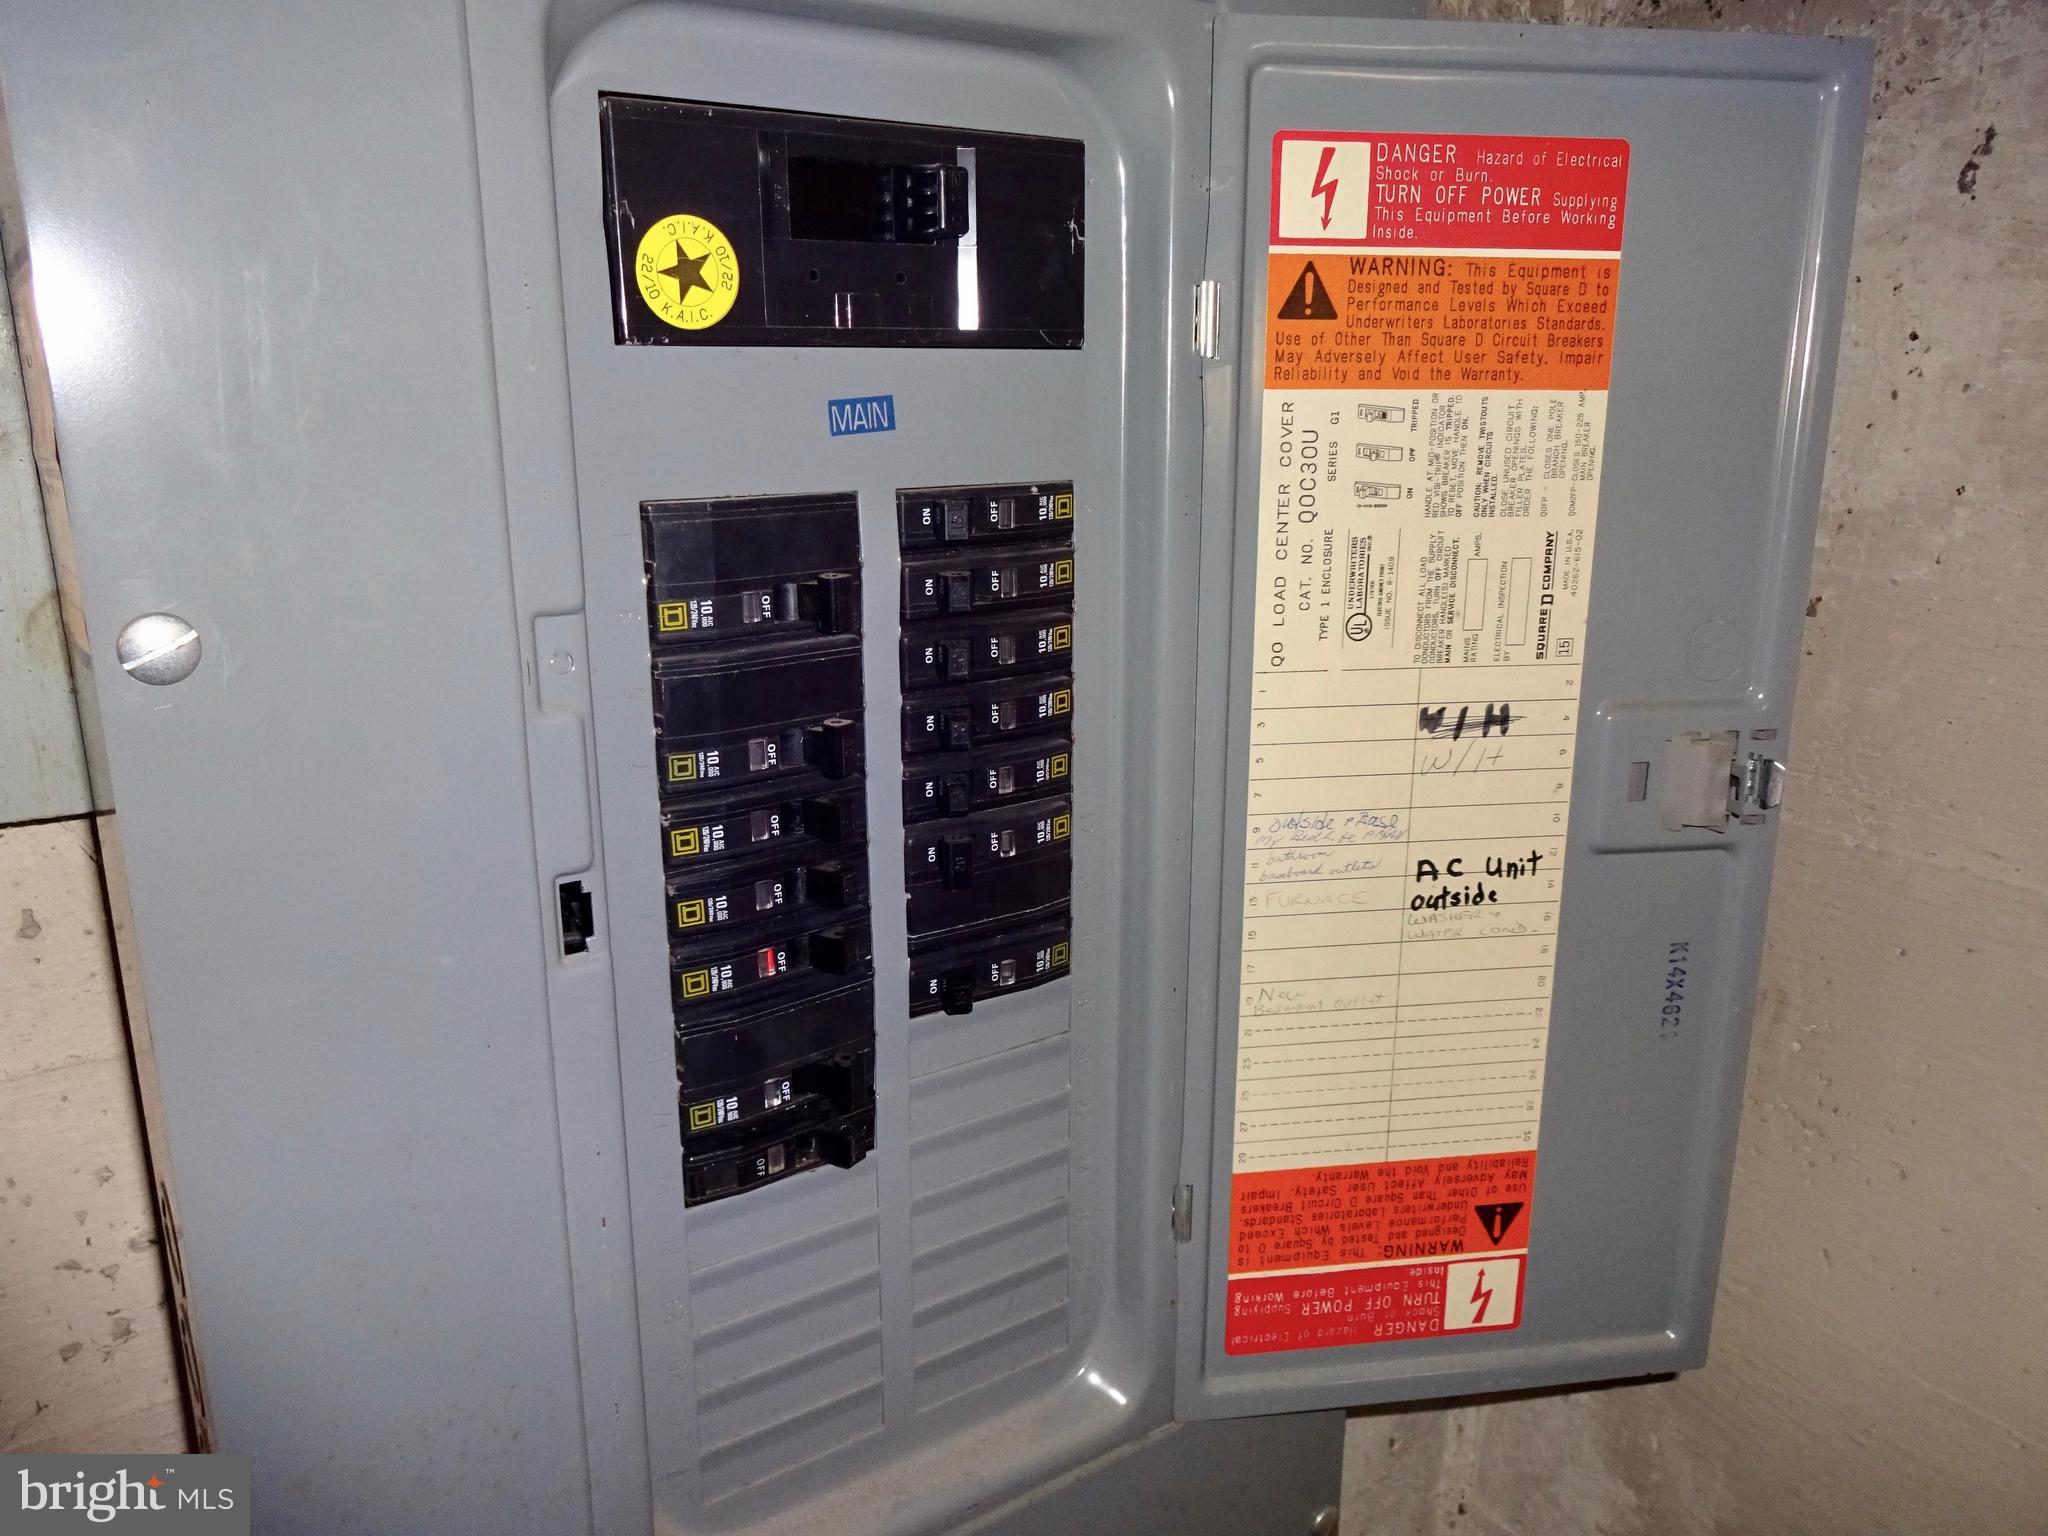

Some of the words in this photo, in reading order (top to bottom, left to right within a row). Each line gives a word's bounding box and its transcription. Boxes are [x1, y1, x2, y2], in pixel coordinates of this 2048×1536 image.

[1376, 143, 1457, 163] DANGER
[1477, 152, 1523, 165] Hazard
[1533, 152, 1546, 166] of
[1556, 152, 1622, 168] Electrical
[1376, 166, 1418, 181] Shock
[1430, 169, 1444, 181] or
[1456, 169, 1493, 182] Burn.
[1376, 184, 1421, 203] TURN
[1436, 186, 1466, 204] OFF
[1482, 187, 1540, 206] POWER
[1553, 193, 1617, 211] Supplying
[1375, 207, 1403, 221] This
[1415, 208, 1491, 225] Equipment
[1502, 210, 1550, 224] Before
[1561, 211, 1616, 229] Working
[1372, 225, 1418, 239] Inside.
[1350, 257, 1452, 277] WARNING:
[1466, 263, 1495, 277] This
[1508, 264, 1586, 282] Equipment
[1598, 266, 1610, 279] is
[1348, 280, 1408, 297] Designed
[1418, 281, 1440, 295] and
[1451, 281, 1494, 295] Tested
[1503, 281, 1516, 298] by
[1527, 282, 1570, 298] Square
[1579, 283, 1587, 296] D
[1597, 284, 1608, 296] to
[1347, 298, 1438, 313] Performance
[1450, 299, 1495, 313] Levels
[1507, 299, 1546, 313] Which
[1557, 300, 1606, 314] Exceed
[1346, 315, 1433, 330] Underwriters
[1444, 316, 1527, 331] Laboratories
[1537, 317, 1605, 332] Standards.
[1276, 331, 1301, 345] Use
[1312, 331, 1324, 346] of
[1335, 332, 1372, 346] Other
[1382, 332, 1411, 346] Than
[1421, 333, 1465, 349] Square
[1475, 333, 1483, 346] D
[1493, 334, 1537, 347] Circuit
[1547, 335, 1603, 348] Breakers
[1275, 350, 1302, 366] May
[1316, 350, 1386, 366] Adversely
[1397, 351, 1444, 364] Affect
[1454, 351, 1487, 364] User
[1497, 352, 1548, 368] Safety.
[1560, 352, 1603, 368] Impair
[1274, 367, 1348, 383] Reliability
[1359, 367, 1380, 381] and
[1393, 367, 1419, 381] Void
[1430, 368, 1450, 381] the
[1461, 368, 1524, 384] Warranty.
[831, 402, 889, 433] MAIN
[1330, 411, 1339, 425] G1
[1411, 399, 1419, 432] TRIPPED
[1479, 397, 1488, 438] TWISTOUTS
[1279, 402, 1294, 467] COVER
[1484, 432, 1493, 467] CIRCUITS
[1328, 441, 1338, 482] SERIES
[1476, 446, 1484, 475] REMOVE
[1482, 472, 1490, 493] WHEN
[1407, 488, 1413, 499] ON
[1473, 482, 1482, 517] CAUTION:
[1489, 474, 1498, 517] INSTALLED.
[923, 509, 930, 524] ON
[1276, 484, 1290, 560] CENTER
[1565, 529, 1574, 552] U.S.A.
[1301, 539, 1314, 564] NO.
[1321, 528, 1333, 594] ENCLOSURE
[1542, 531, 1554, 590] COMPANY
[1564, 557, 1571, 565] IN
[1348, 536, 1358, 609] UNDERWRITERS
[1356, 537, 1366, 609] LABORATORIES
[1387, 557, 1395, 585] R-1409
[1450, 537, 1460, 588] DISCONNECT.
[1570, 529, 1583, 597] 40262-615-02
[926, 579, 933, 595] ON
[1299, 577, 1312, 611] CAT.
[1498, 561, 1508, 609] INSPECTION
[762, 596, 770, 618] OFF
[1273, 576, 1287, 626] LOAD
[1448, 593, 1456, 624] SERVICE
[1540, 594, 1554, 606] D
[1319, 616, 1329, 641] TYPE
[1493, 614, 1504, 661] ELECTRICAL
[1536, 609, 1548, 660] SQUARE
[925, 648, 933, 663] ON
[1270, 642, 1284, 667] QO
[1470, 633, 1479, 662] RATING
[1504, 651, 1510, 661] BY
[1558, 640, 1570, 655] 15
[927, 715, 934, 731] ON
[768, 744, 776, 765] OFF
[926, 782, 933, 797] ON
[770, 815, 779, 836] OFF
[928, 847, 936, 862] ON
[774, 883, 782, 904] OFF
[1410, 882, 1498, 911] outside
[778, 952, 786, 972] OFF
[930, 980, 937, 994] ON
[782, 1081, 790, 1101] OFF
[756, 1158, 764, 1176] OFF
[1377, 1239, 1464, 1257] WARNING:
[1301, 1299, 1352, 1314] POWER
[1365, 1295, 1391, 1310] OFF
[1403, 1291, 1440, 1306] TURN
[1374, 1318, 1439, 1336] DANGER
